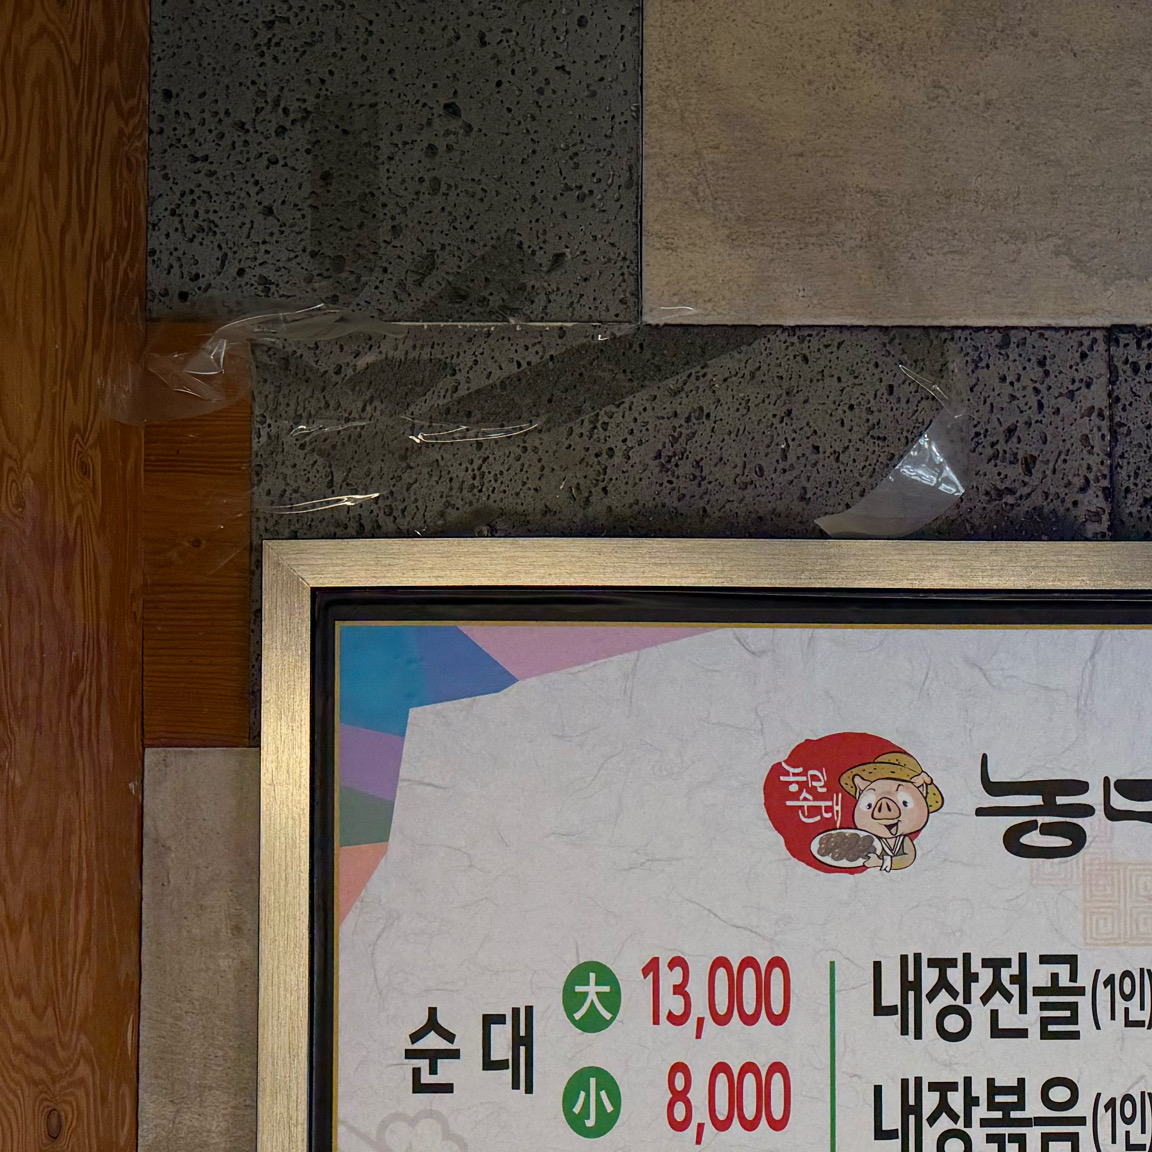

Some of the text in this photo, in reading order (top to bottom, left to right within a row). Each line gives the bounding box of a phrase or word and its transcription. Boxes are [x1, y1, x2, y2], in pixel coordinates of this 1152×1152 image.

[573, 955, 791, 1040] 大 13,000
[572, 1061, 792, 1146] 小 8,000
